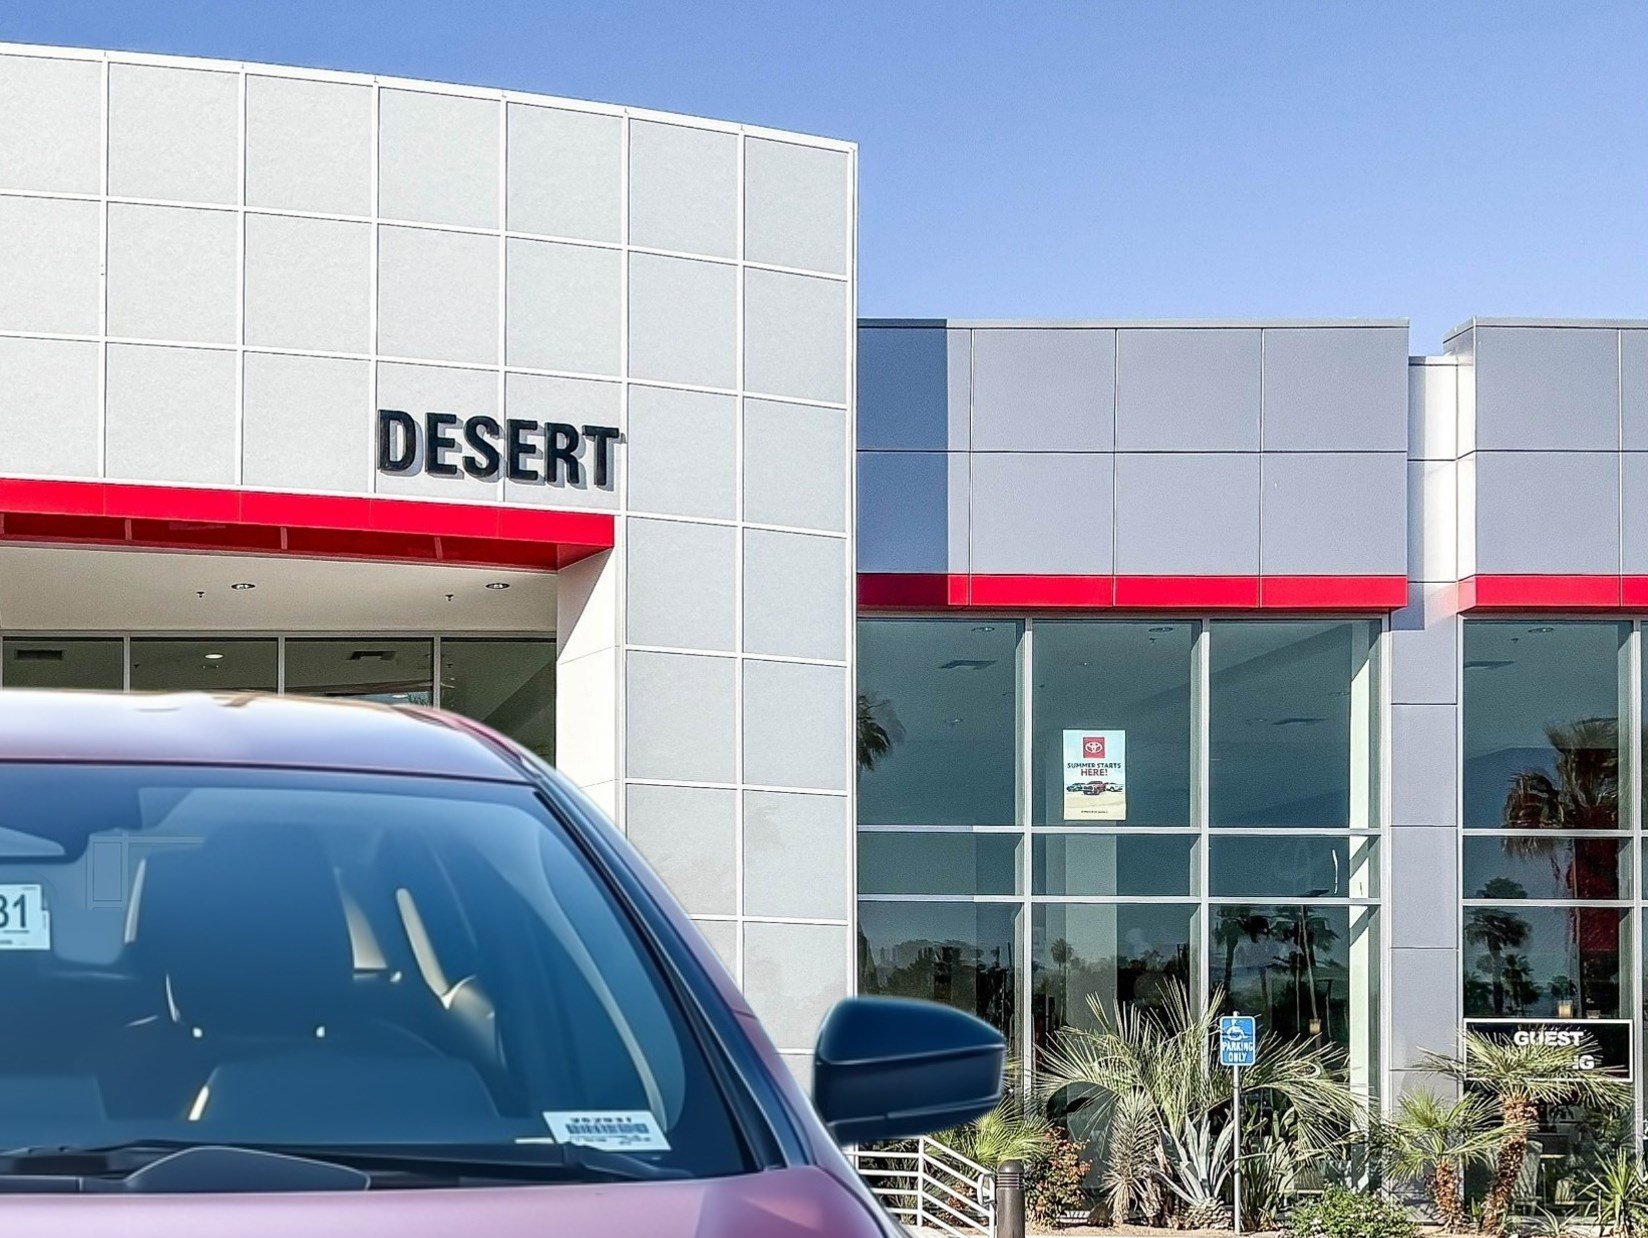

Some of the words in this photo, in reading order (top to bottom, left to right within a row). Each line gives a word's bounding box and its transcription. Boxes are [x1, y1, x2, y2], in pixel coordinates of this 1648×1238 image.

[377, 408, 621, 487] DESERT
[1080, 768, 1108, 777] HERE!
[1513, 1030, 1585, 1048] GUEST
[1222, 1041, 1254, 1052] PARKING
[1228, 1051, 1248, 1062] ONLY
